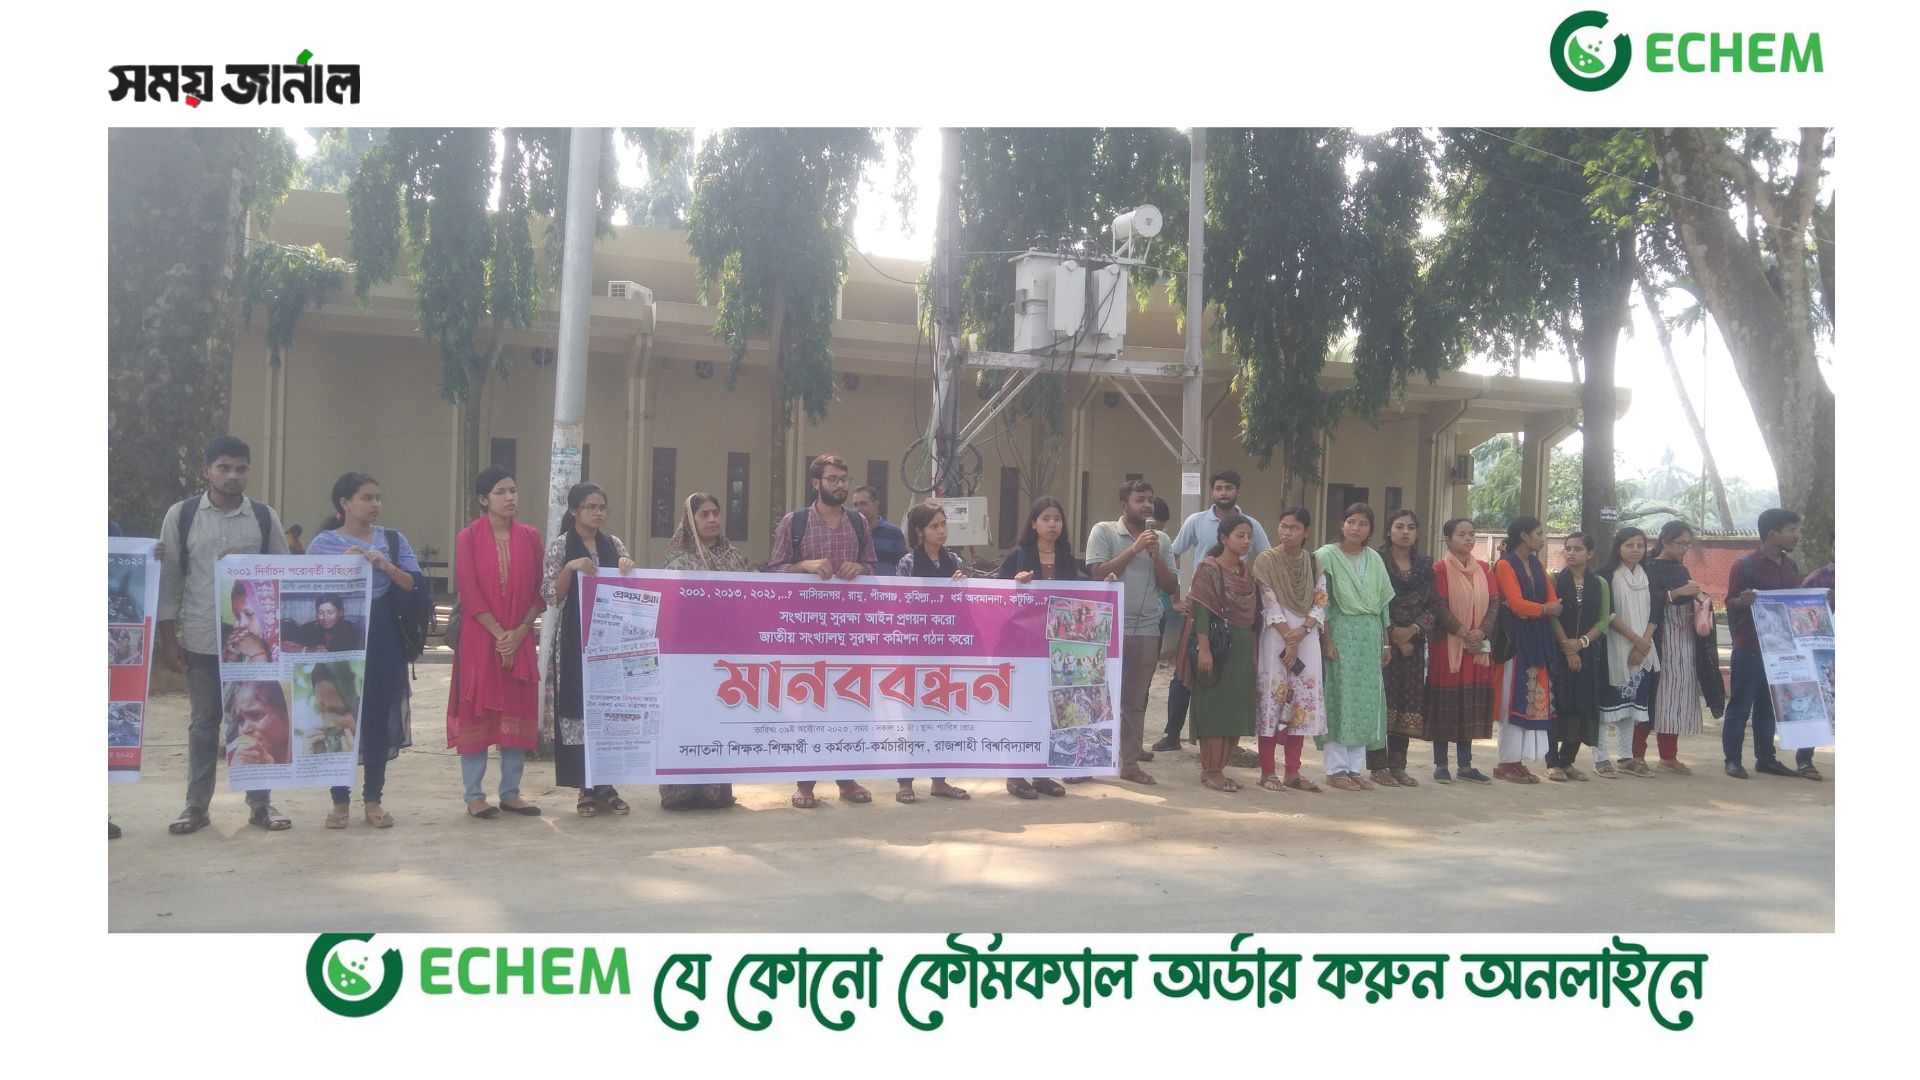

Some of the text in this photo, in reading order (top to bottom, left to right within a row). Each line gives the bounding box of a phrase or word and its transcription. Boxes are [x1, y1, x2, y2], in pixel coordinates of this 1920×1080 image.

[226, 567, 251, 576] ২০০১
[255, 564, 284, 576] নির্বাচন
[950, 591, 963, 602] ধর্ম
[779, 611, 956, 627] সংখ্যালঘু সুরক্ষা আইন প্রণয়ন করো
[758, 627, 975, 647] জাতীয় সংখ্যালঘু সুরক্ষা কমিশন গঠন করো
[714, 659, 1016, 713] মানববন্ধন
[679, 737, 1042, 757] সনাতনী শিক্ষক-শিক্ষার্থী ও কর্মকর্তা-কর্মচারীবৃন্দ, রাজশাহী বিশ্ববিদ্যালয়
